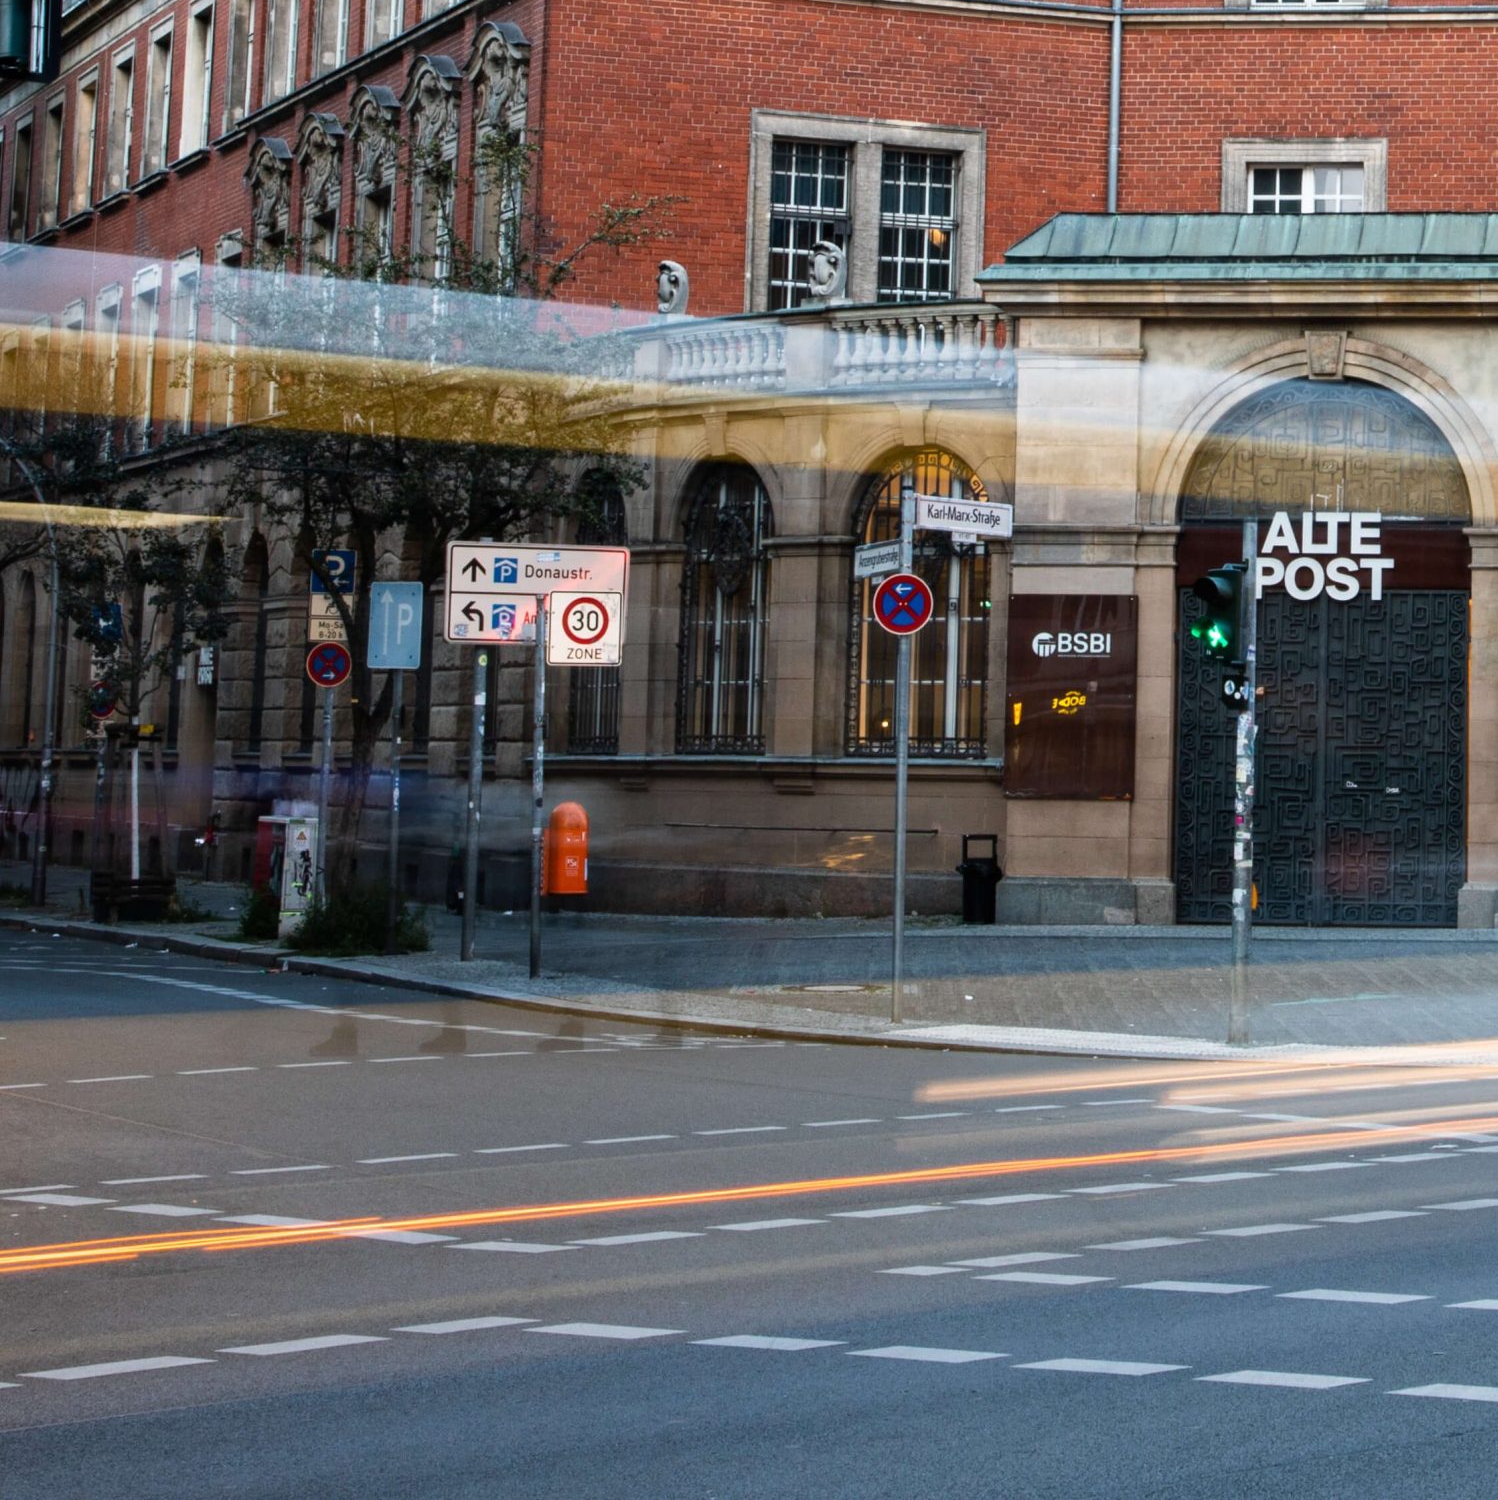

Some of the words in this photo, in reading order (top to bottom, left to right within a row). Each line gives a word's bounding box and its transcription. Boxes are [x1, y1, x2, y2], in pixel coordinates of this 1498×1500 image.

[927, 504, 1001, 528] Karl-Marx-Straße
[1261, 511, 1382, 554] ALTE
[525, 564, 593, 581] Donaustr.
[1256, 557, 1395, 601] POST
[572, 610, 599, 632] 30
[567, 648, 603, 660] ZONE
[1057, 632, 1111, 654] BSBI
